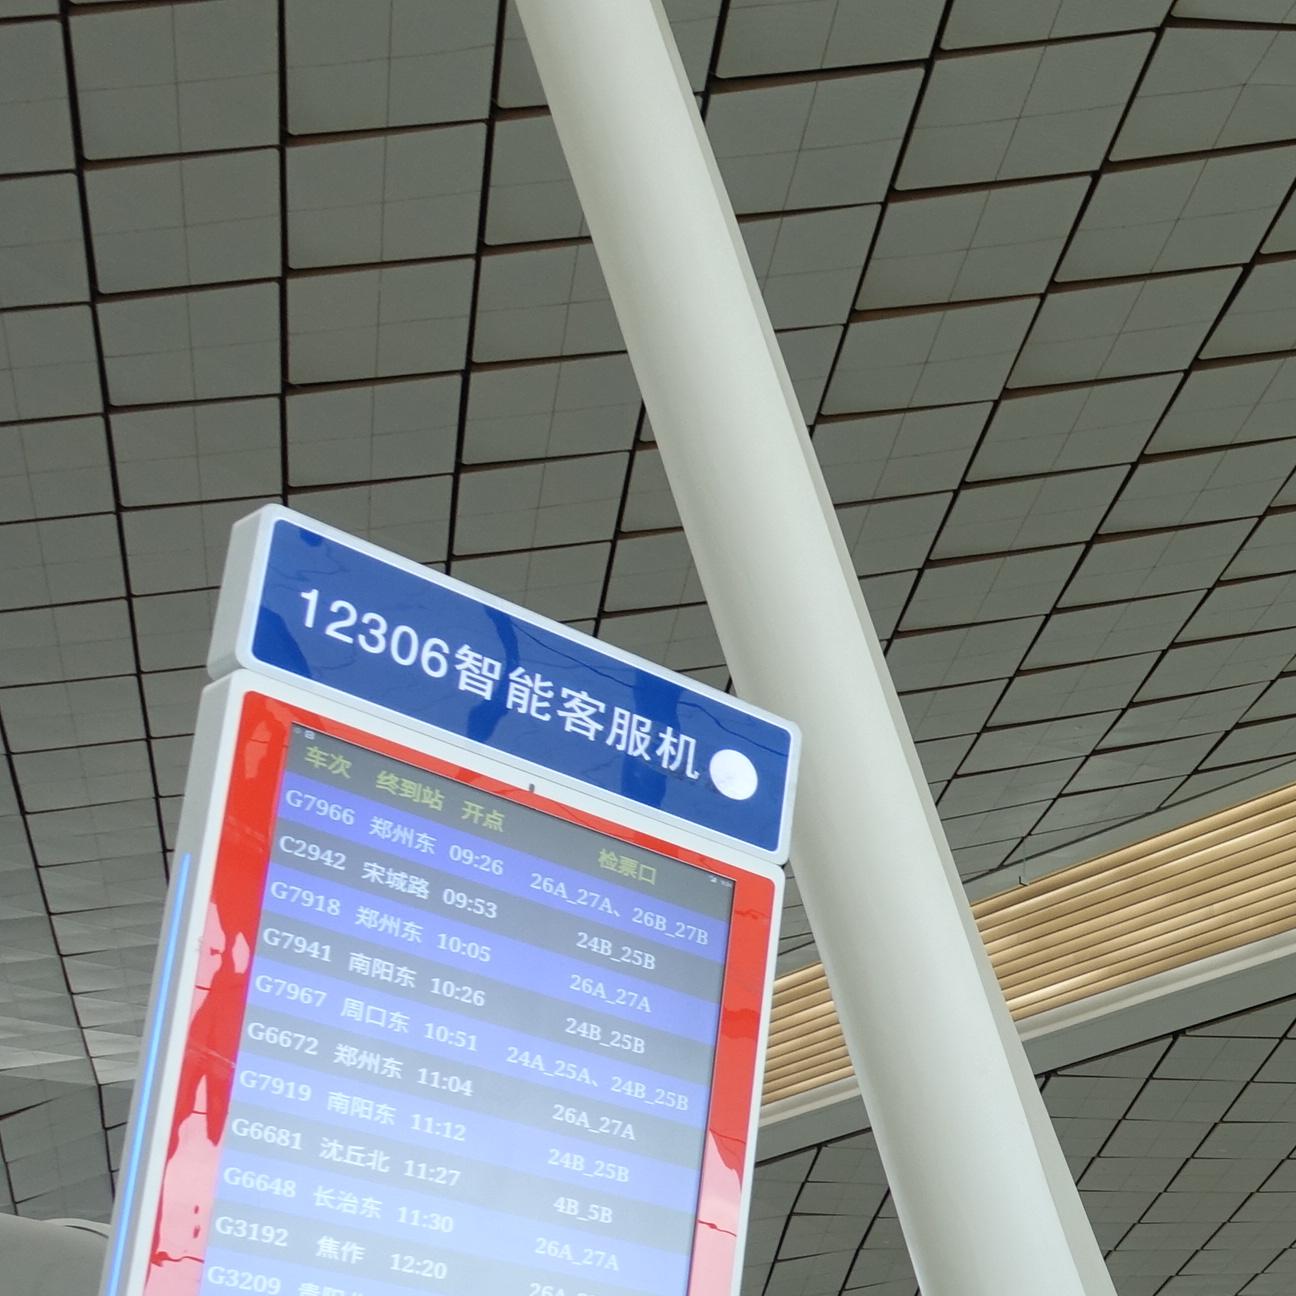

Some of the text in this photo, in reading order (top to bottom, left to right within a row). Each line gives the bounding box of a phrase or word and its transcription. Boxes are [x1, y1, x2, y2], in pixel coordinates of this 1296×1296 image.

[300, 588, 700, 780] 12306智能客服机
[285, 789, 355, 826] G7966
[369, 816, 436, 855] 郑州东
[449, 844, 504, 876] 09:26
[305, 746, 656, 885] 车次 终到站 开点 检票口
[270, 882, 652, 1013] G7918 郑州东 10:05 26A_27A
[279, 836, 656, 970] C2942 宋城路 09:53 24B_25B
[255, 975, 327, 1007] G7967
[340, 998, 410, 1033] 周口东
[424, 1023, 478, 1051] 10:51
[263, 927, 645, 1054] G7941 南阳东 10:26 24B_25B
[239, 1070, 629, 1183] G7919 南阳东 11:12 24B_25B
[247, 1022, 636, 1140] G6672 郑州东 11:04 26A_27A
[223, 1167, 620, 1271] G6648 长治东 11:30 26A_27A
[231, 1118, 613, 1224] G6681 沈丘北 11:27 4B_5B
[207, 1265, 281, 1296] G3209
[215, 1216, 288, 1247] G3192
[316, 1235, 366, 1264] 焦作
[389, 1253, 448, 1280] 12:20
